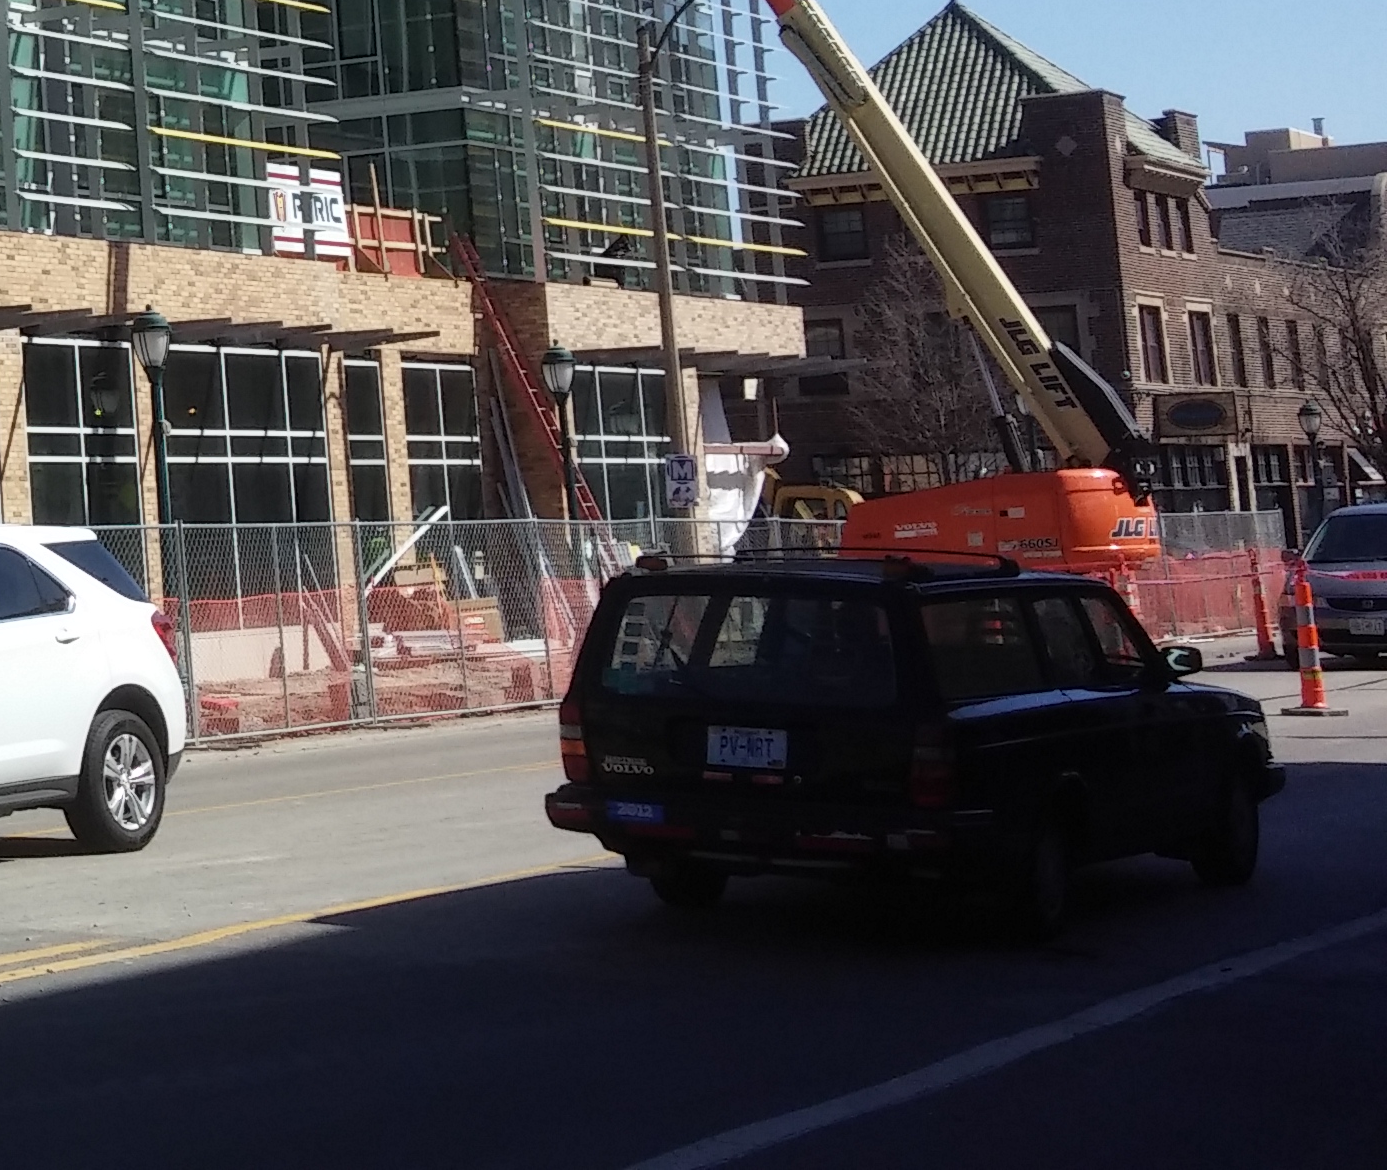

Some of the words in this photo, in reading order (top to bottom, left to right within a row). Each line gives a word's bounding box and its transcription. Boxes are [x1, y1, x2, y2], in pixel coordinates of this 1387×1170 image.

[291, 192, 343, 224] PRIC
[998, 317, 1041, 356] JLG
[1029, 362, 1078, 409] LIFT
[894, 521, 939, 531] VOLVO
[1110, 518, 1146, 538] JLG
[601, 762, 656, 776] VOLVO
